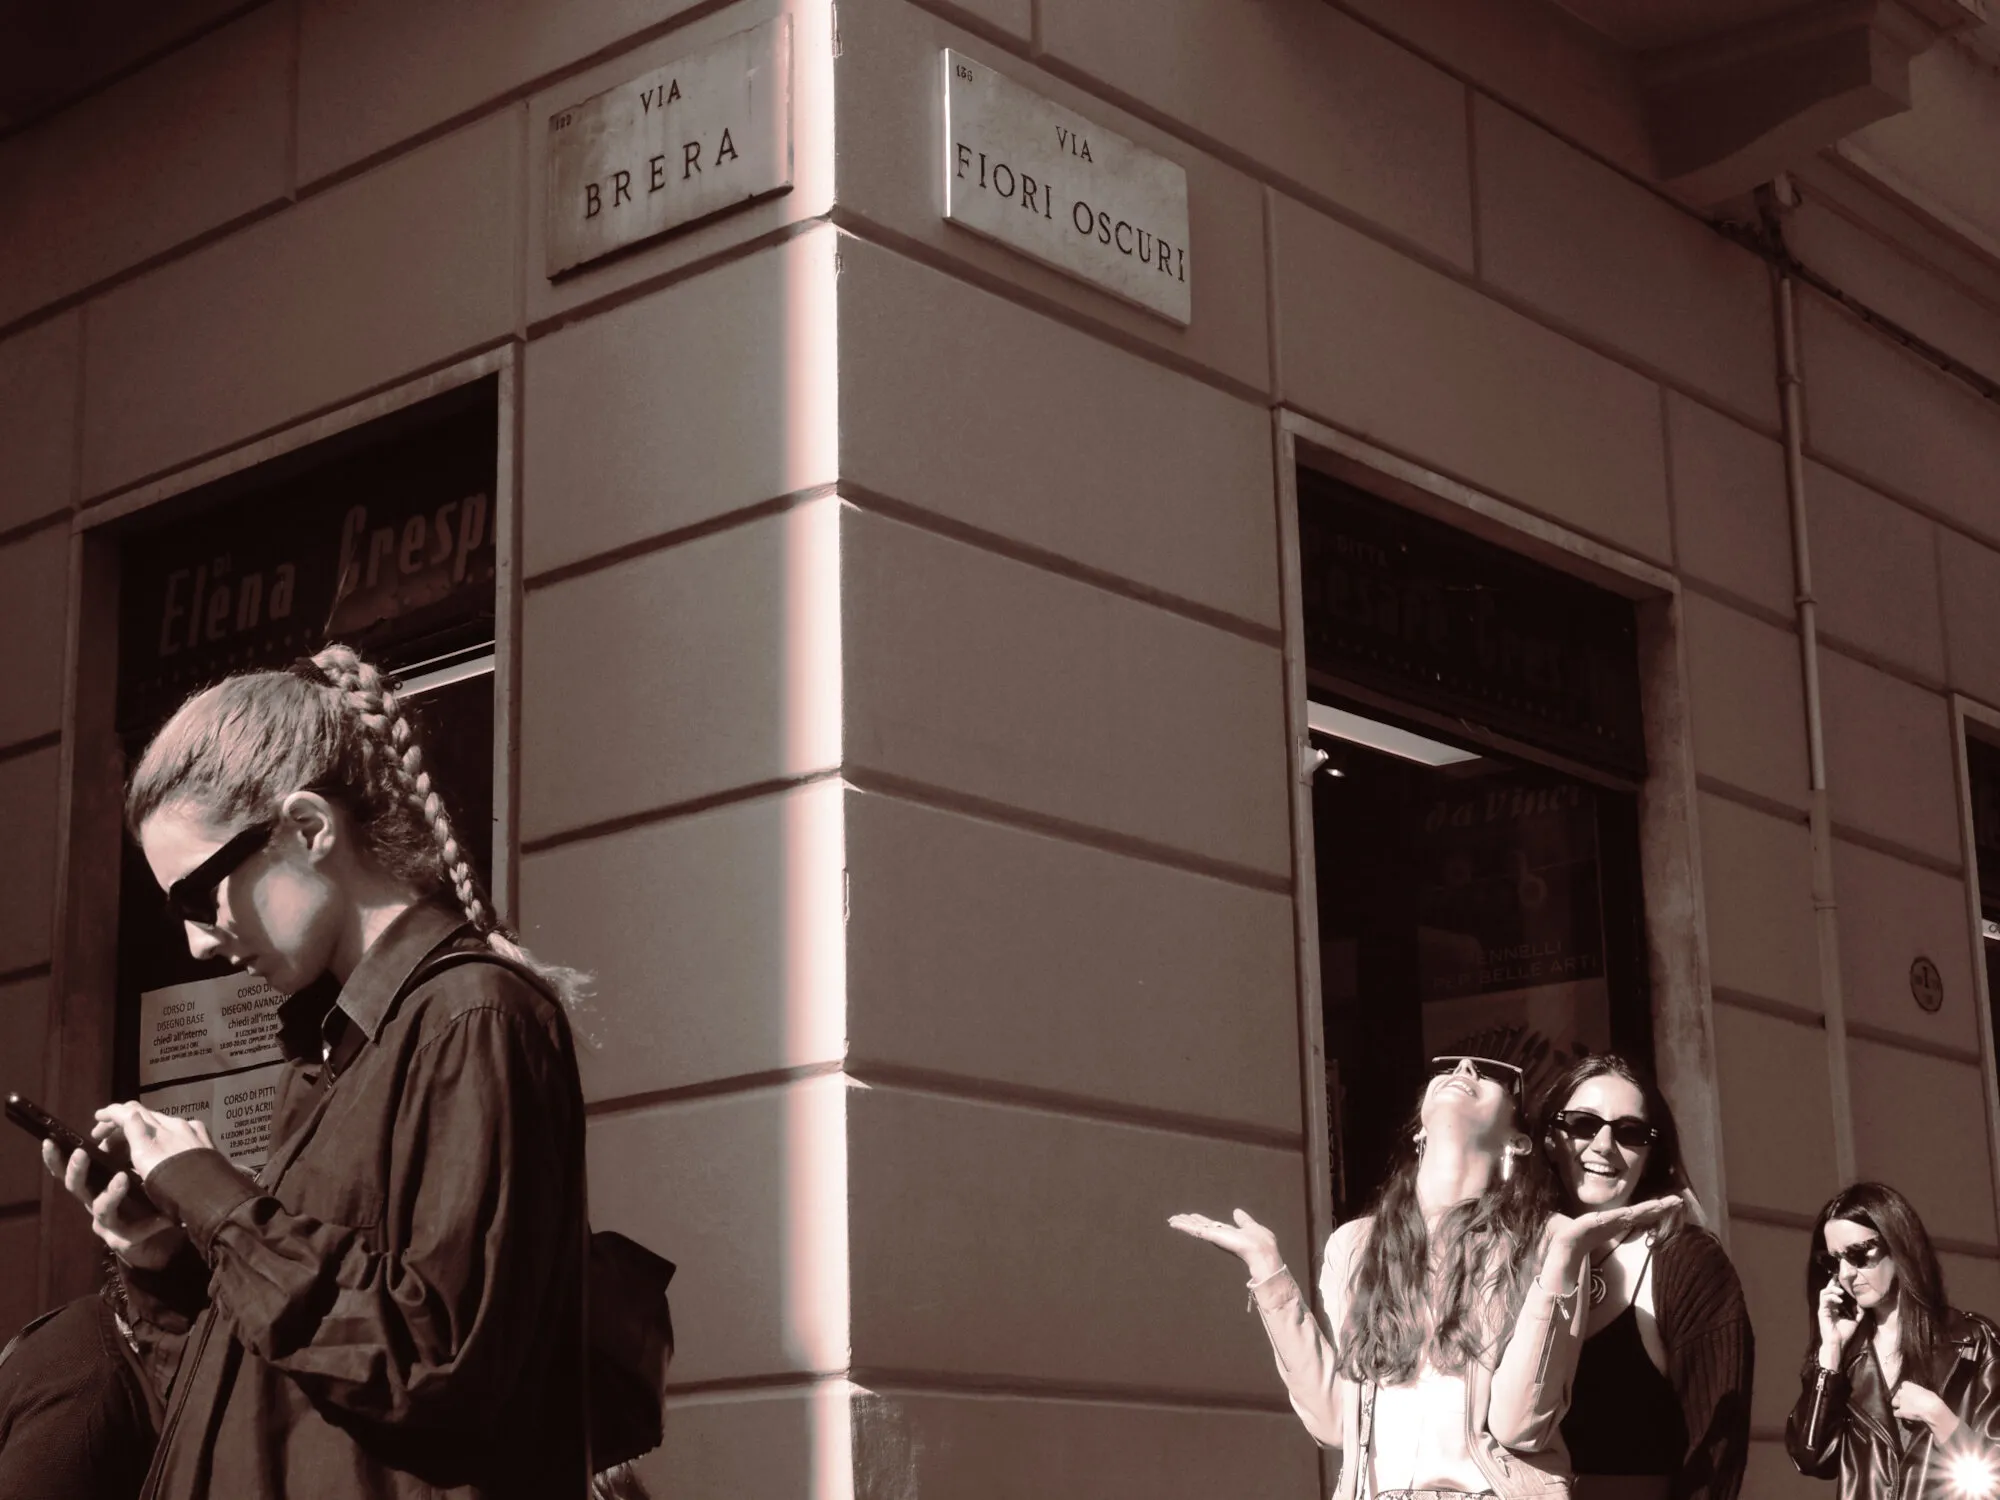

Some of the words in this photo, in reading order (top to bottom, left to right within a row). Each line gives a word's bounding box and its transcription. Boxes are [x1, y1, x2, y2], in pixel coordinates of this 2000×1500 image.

[640, 78, 682, 114] VIA
[1055, 125, 1093, 163] VIA
[585, 127, 738, 219] BRERA
[956, 142, 1053, 220] FIORI
[1073, 200, 1185, 282] OSCURI
[157, 561, 296, 658] Elena
[1479, 961, 1543, 985] BELLE
[1551, 955, 1596, 975] ARTI
[238, 984, 262, 998] CORSO
[162, 1002, 185, 1016] CORSO
[186, 1001, 195, 1012] DI
[221, 1001, 252, 1016] DISEGNO
[157, 1018, 185, 1032] DISEGNO
[186, 1013, 205, 1025] BASE
[228, 1016, 250, 1030] chiedi
[251, 1012, 278, 1025] all'inter
[153, 1034, 172, 1046] chiedi
[224, 1092, 248, 1106] CORSO
[250, 1090, 256, 1100] DI
[171, 1106, 178, 1115] DI
[180, 1101, 210, 1114] PITTURA
[226, 1108, 243, 1119] OLIO
[245, 1105, 253, 1114] VS
[225, 1130, 244, 1139] LEZIONI
